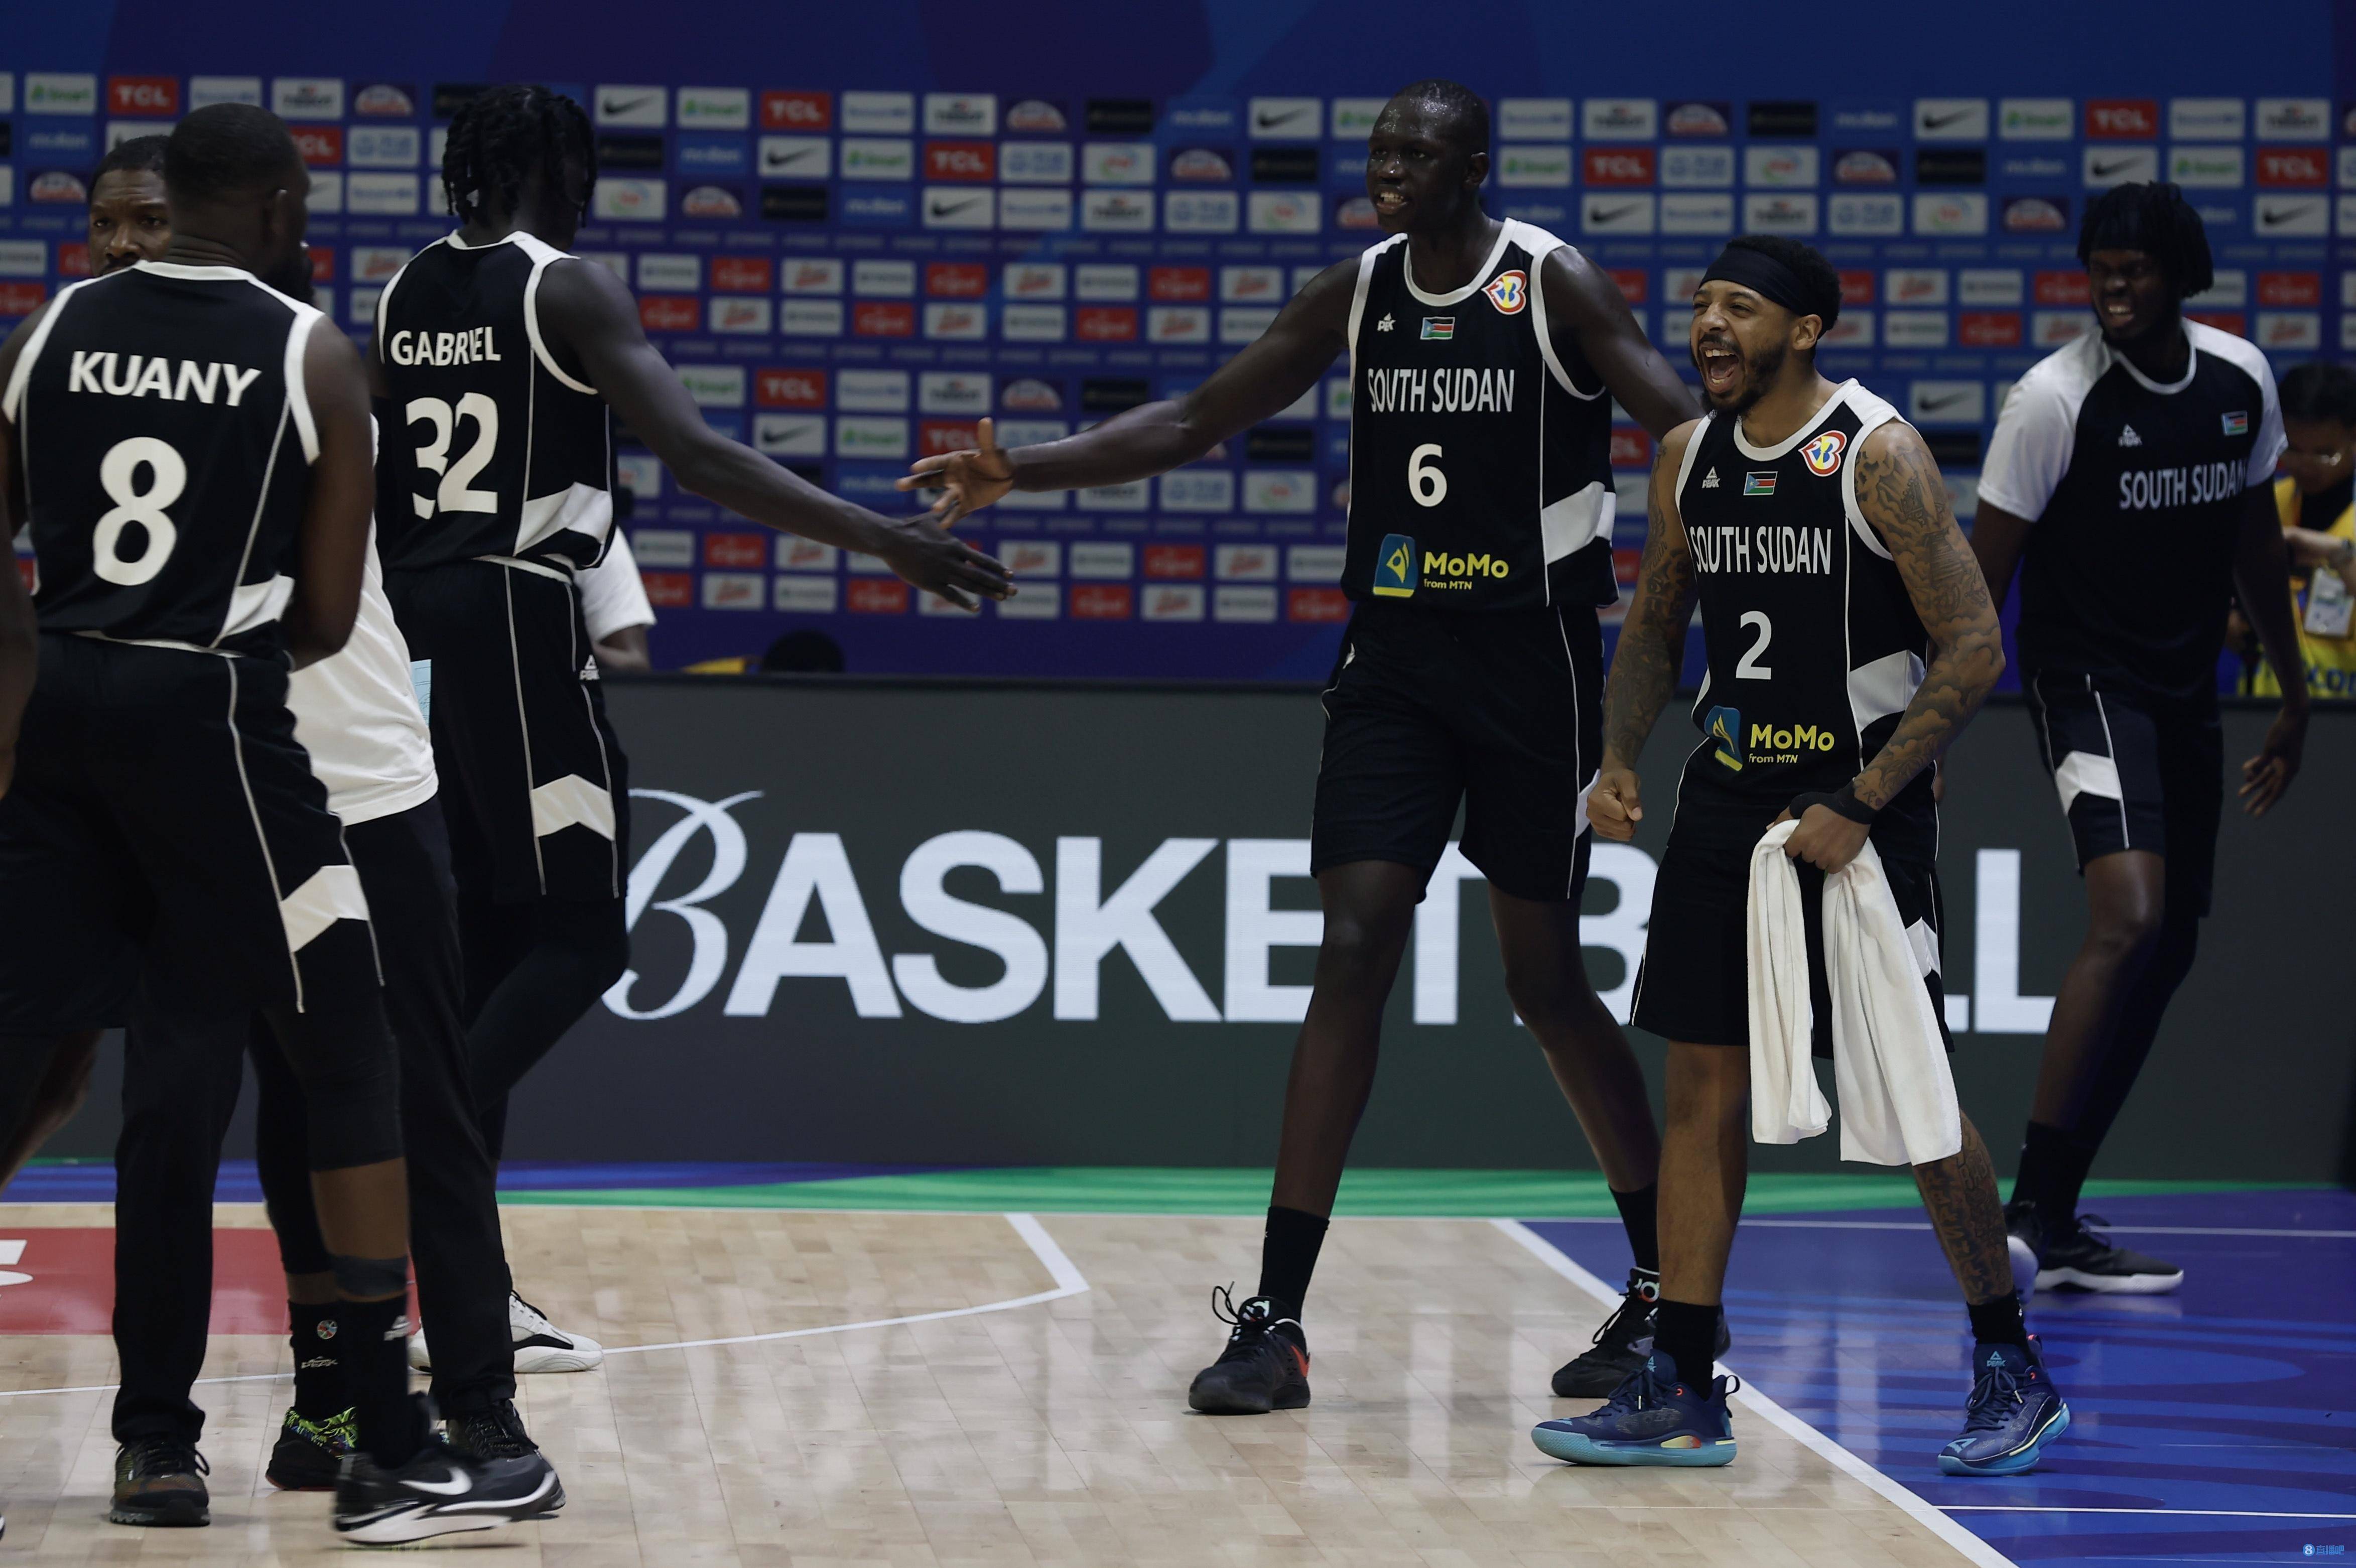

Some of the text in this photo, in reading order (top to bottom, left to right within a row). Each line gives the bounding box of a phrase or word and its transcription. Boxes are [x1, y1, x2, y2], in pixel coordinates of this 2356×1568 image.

[117, 85, 168, 106] TCL
[769, 100, 821, 121] TCL
[2095, 109, 2148, 129] TCL
[292, 136, 333, 156] CL
[933, 151, 985, 172] TCL
[1593, 157, 1645, 177] TCL
[2266, 157, 2317, 178] TCL
[390, 326, 501, 366] GABRIEL
[68, 351, 261, 407] KUANY
[765, 378, 816, 399] TCL
[1367, 368, 1515, 413] SOUTH SUDAN
[929, 430, 980, 449] TCL
[1612, 436, 1641, 456] CL
[406, 393, 498, 520] 32
[1408, 443, 1448, 507] 6
[1701, 478, 1720, 489] PEAK
[2119, 459, 2246, 510] SOUTH SUDAN
[93, 436, 187, 586] 8
[1689, 526, 1751, 574] SOUTH
[1757, 526, 1831, 575] SUDAN
[1423, 551, 1509, 578] MoMo
[1423, 578, 1472, 590] from MTN
[1736, 610, 1772, 680] 2
[1750, 724, 1835, 751] MoMo
[1749, 753, 1798, 763] from MTN
[602, 789, 2057, 1035] BASKETBL
